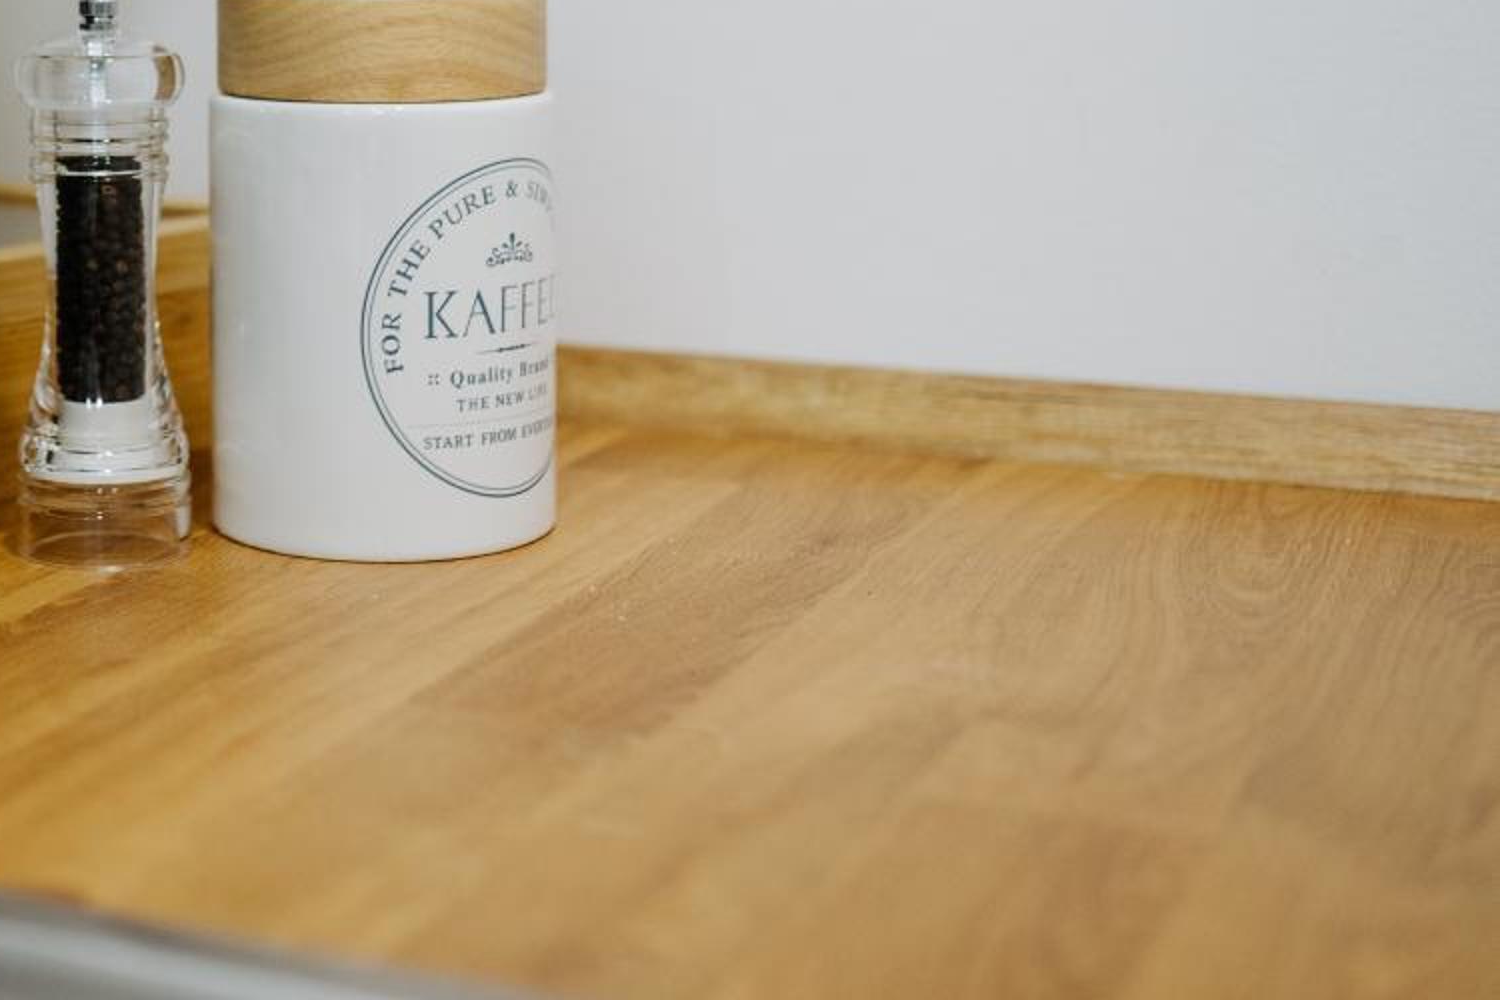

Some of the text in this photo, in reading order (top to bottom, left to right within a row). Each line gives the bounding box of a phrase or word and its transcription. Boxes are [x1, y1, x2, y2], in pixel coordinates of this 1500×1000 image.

[505, 179, 518, 198] &
[428, 185, 497, 240] PURE
[387, 239, 432, 297] THE
[381, 313, 404, 374] FOR
[450, 366, 513, 389] Quality
[456, 396, 490, 412] THE
[495, 391, 524, 408] NEW
[423, 434, 474, 450] START
[481, 427, 517, 446] FROM
